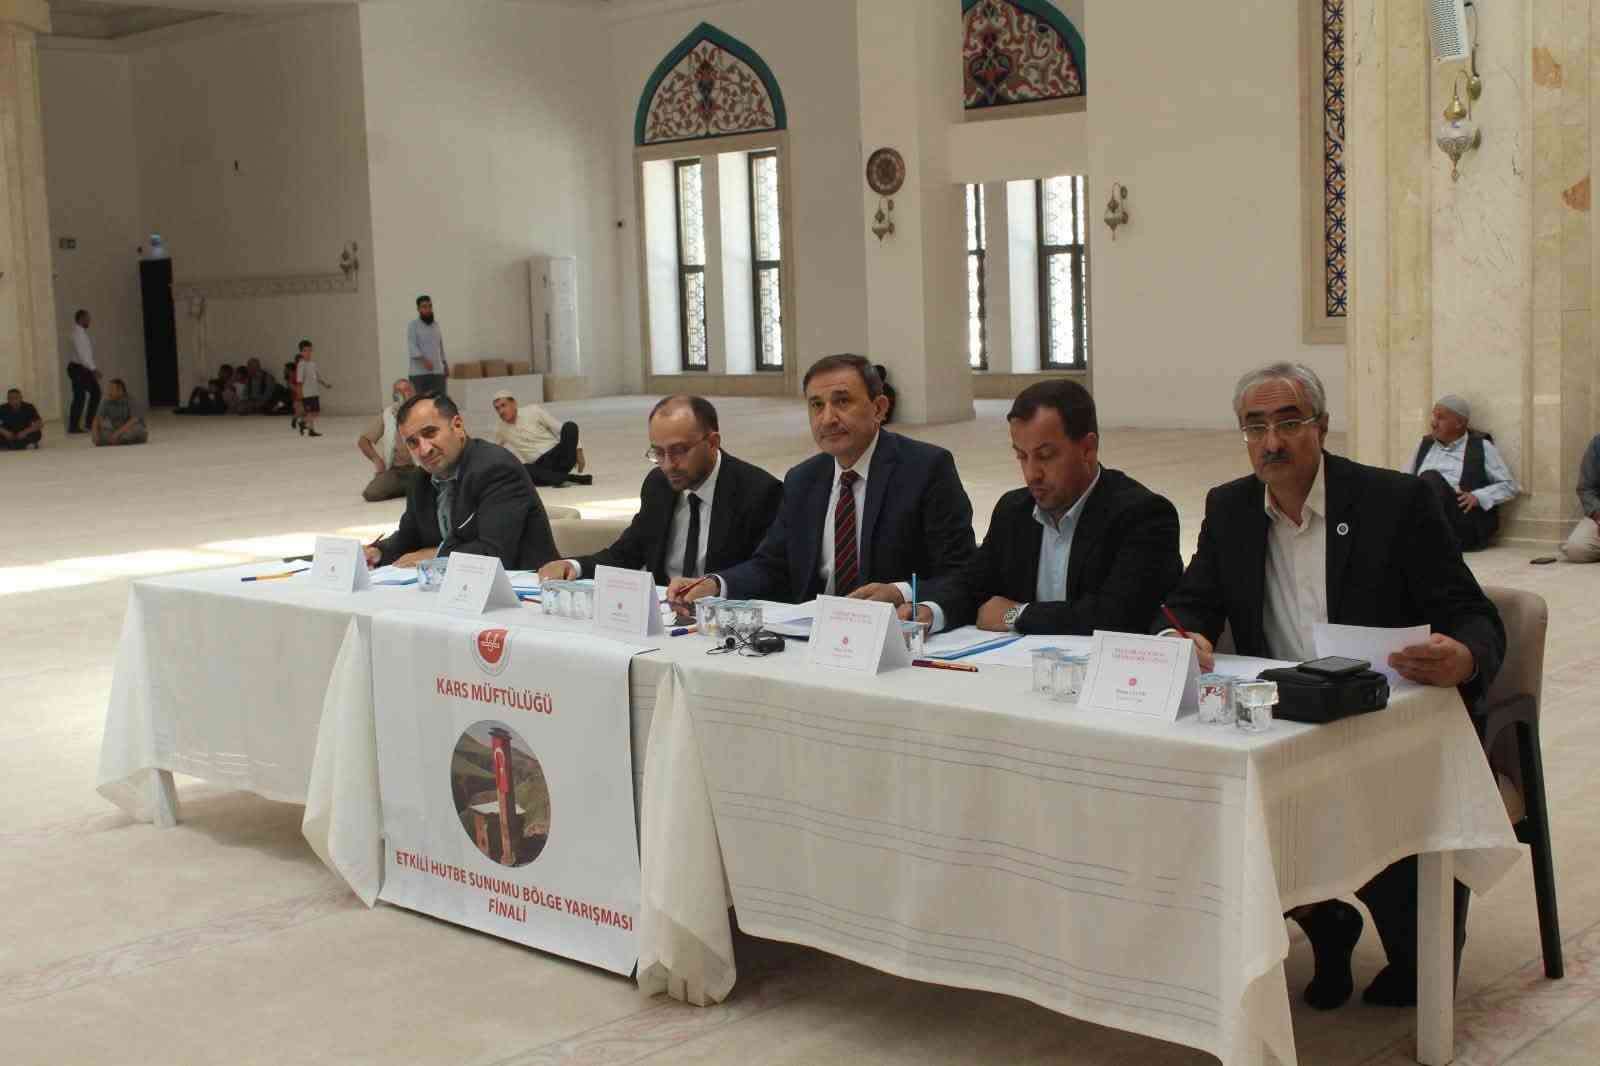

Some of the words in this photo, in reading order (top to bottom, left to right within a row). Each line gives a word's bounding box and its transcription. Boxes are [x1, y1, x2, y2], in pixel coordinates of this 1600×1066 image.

[436, 677, 468, 699] KARS
[471, 683, 553, 715] MÜFTÜLÜĞÜ
[396, 850, 429, 873] ETKİLİ
[431, 860, 467, 884] HUTBE
[469, 872, 519, 898] SUNUMU
[523, 885, 562, 912] BÖLGE
[564, 898, 633, 931] YARIŞMASI
[488, 898, 527, 923] FİNALİ
